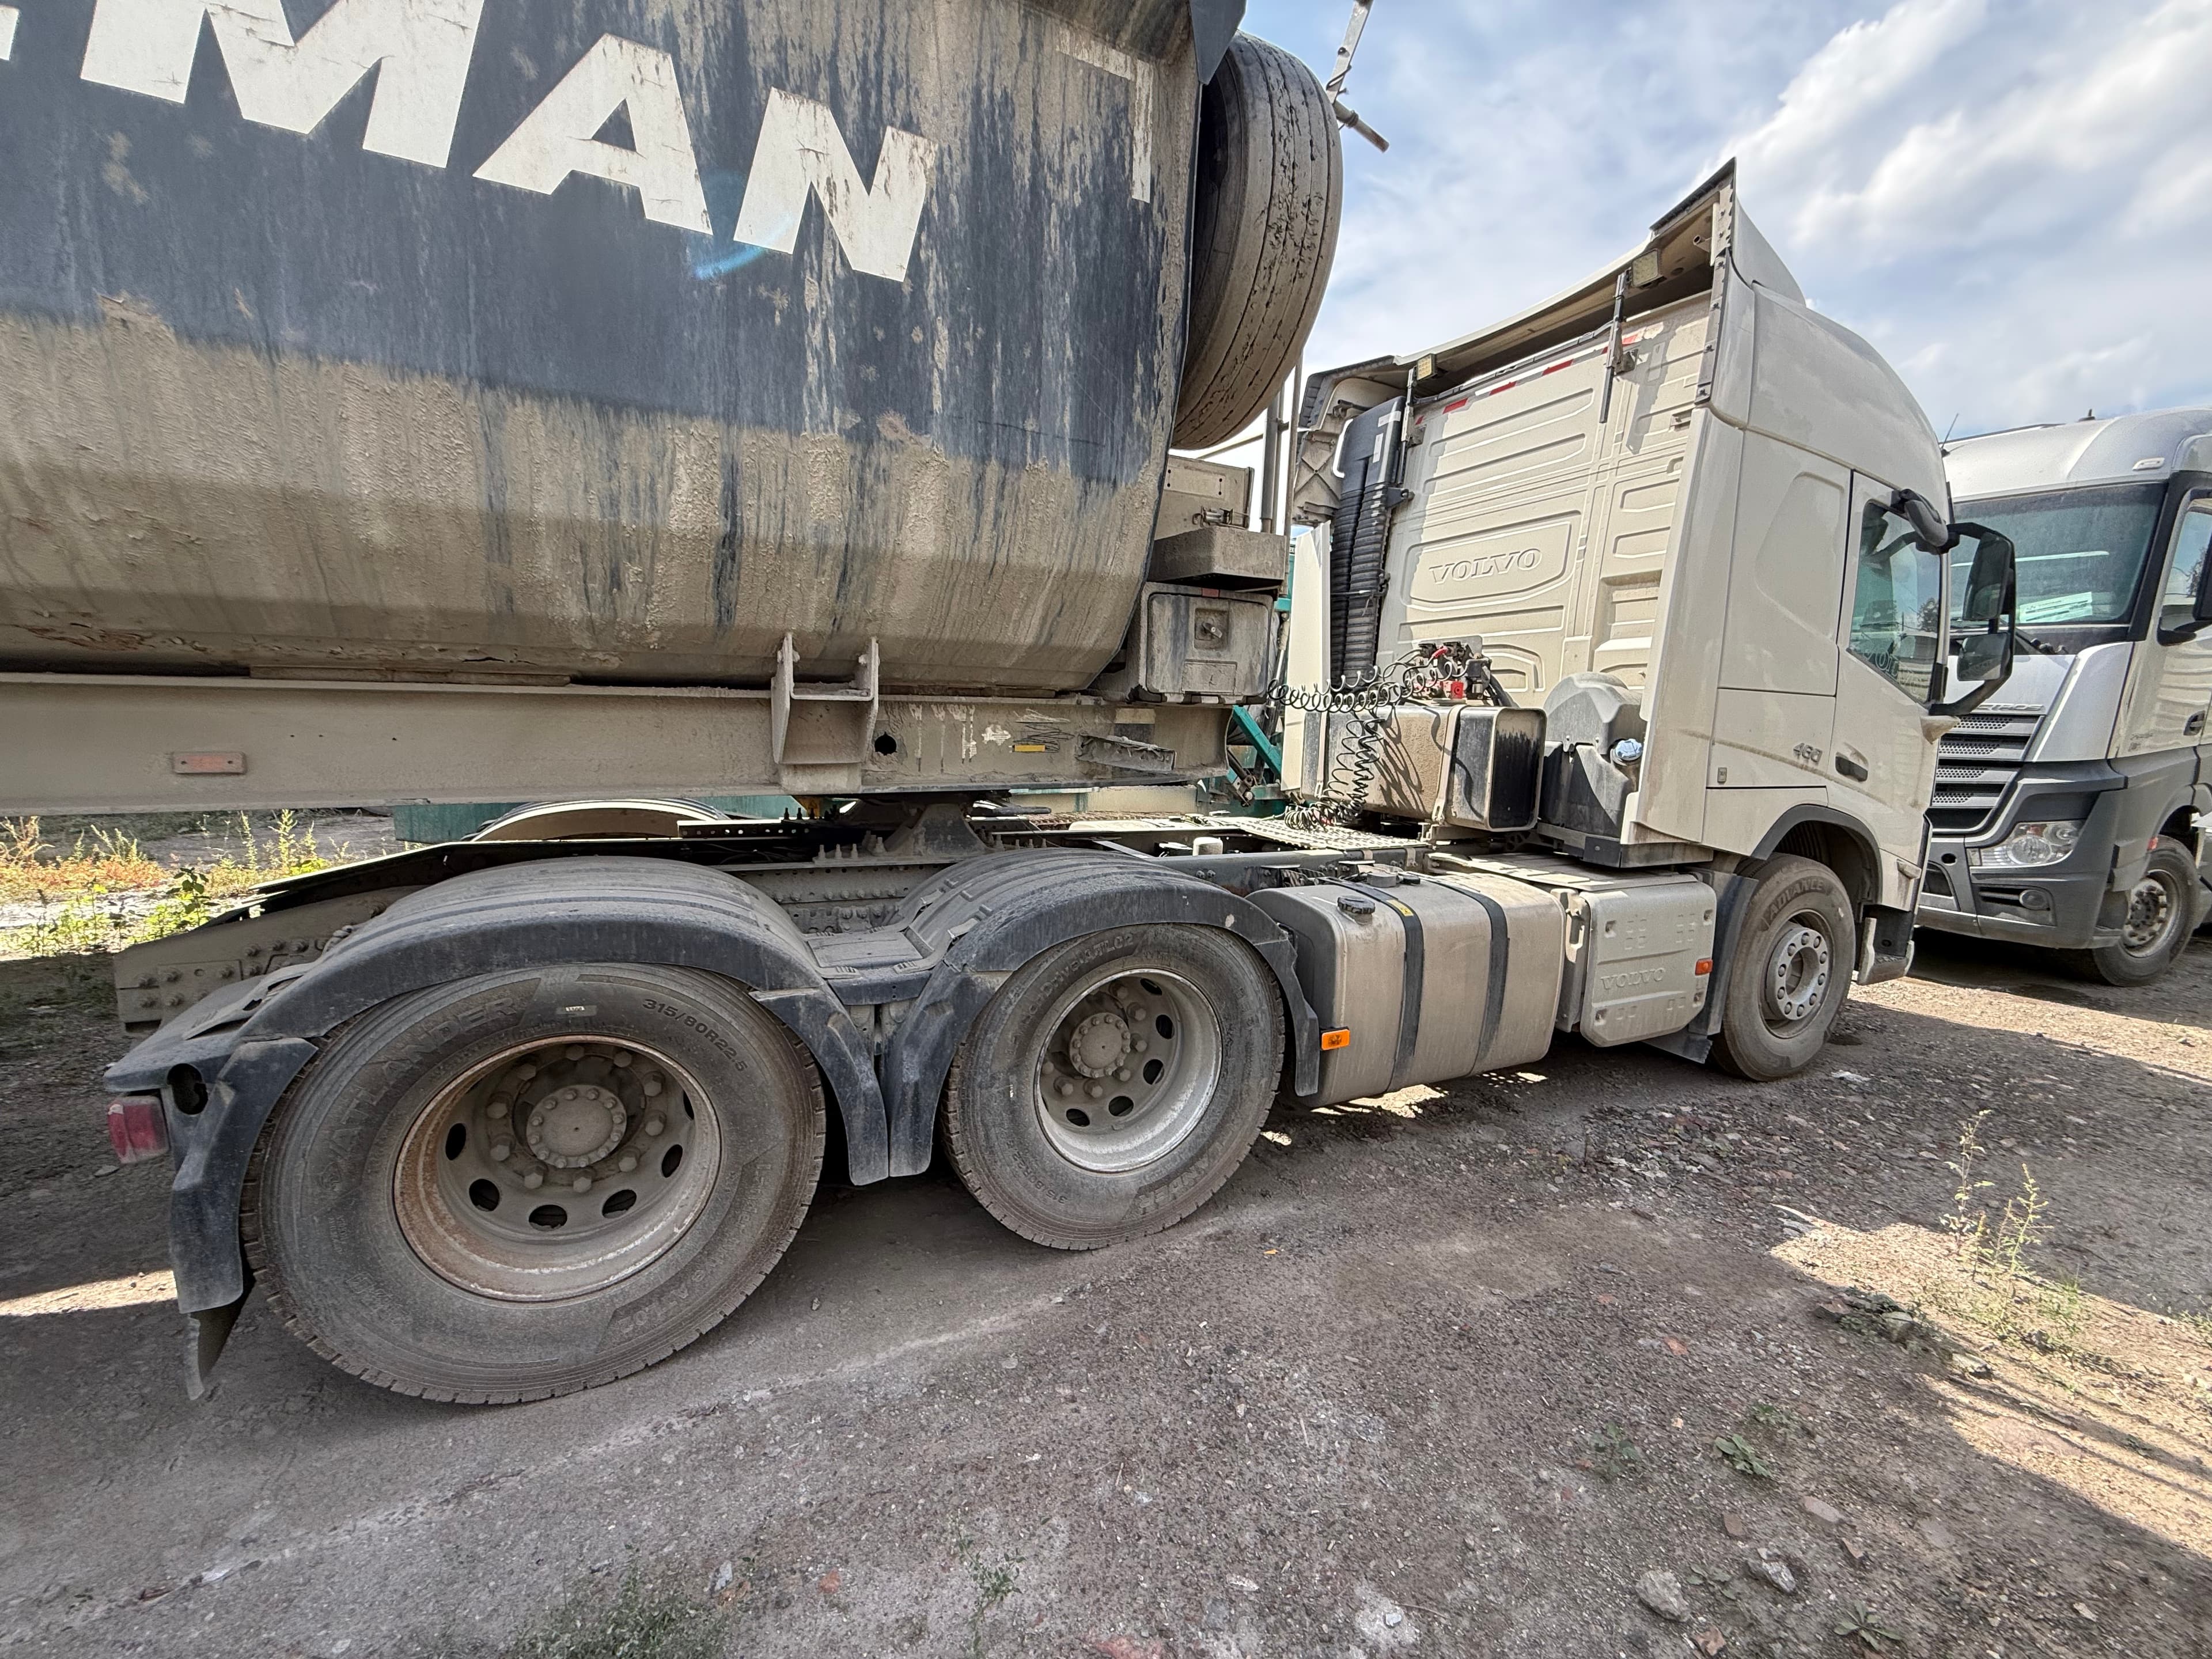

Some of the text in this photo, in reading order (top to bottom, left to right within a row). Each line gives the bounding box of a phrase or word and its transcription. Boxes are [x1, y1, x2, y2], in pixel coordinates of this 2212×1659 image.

[0, 0, 939, 282] MAN
[1429, 548, 1543, 585] VOLVO
[1978, 702, 2047, 711] CTROS
[1793, 743, 1823, 763] 460
[1768, 878, 1824, 921] ADVANCE
[1600, 968, 1666, 990] VOLVO
[641, 998, 748, 1073] 315/80R22.5
[326, 997, 517, 1157] ATLANDER
